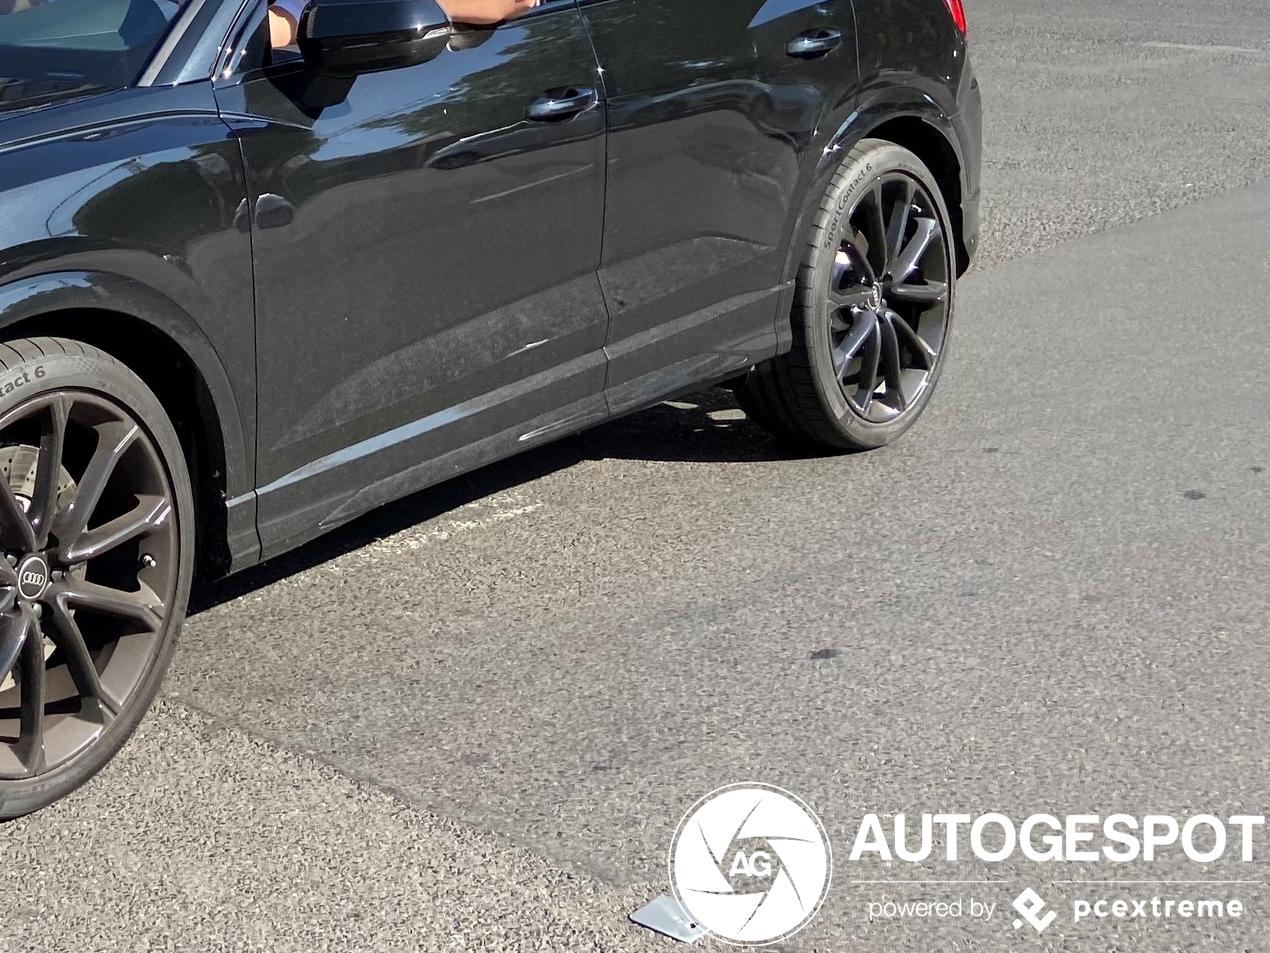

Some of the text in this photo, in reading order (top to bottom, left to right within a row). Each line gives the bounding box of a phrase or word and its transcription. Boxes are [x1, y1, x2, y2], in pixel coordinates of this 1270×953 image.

[824, 162, 873, 250] SportContact 6
[34, 365, 46, 378] 6
